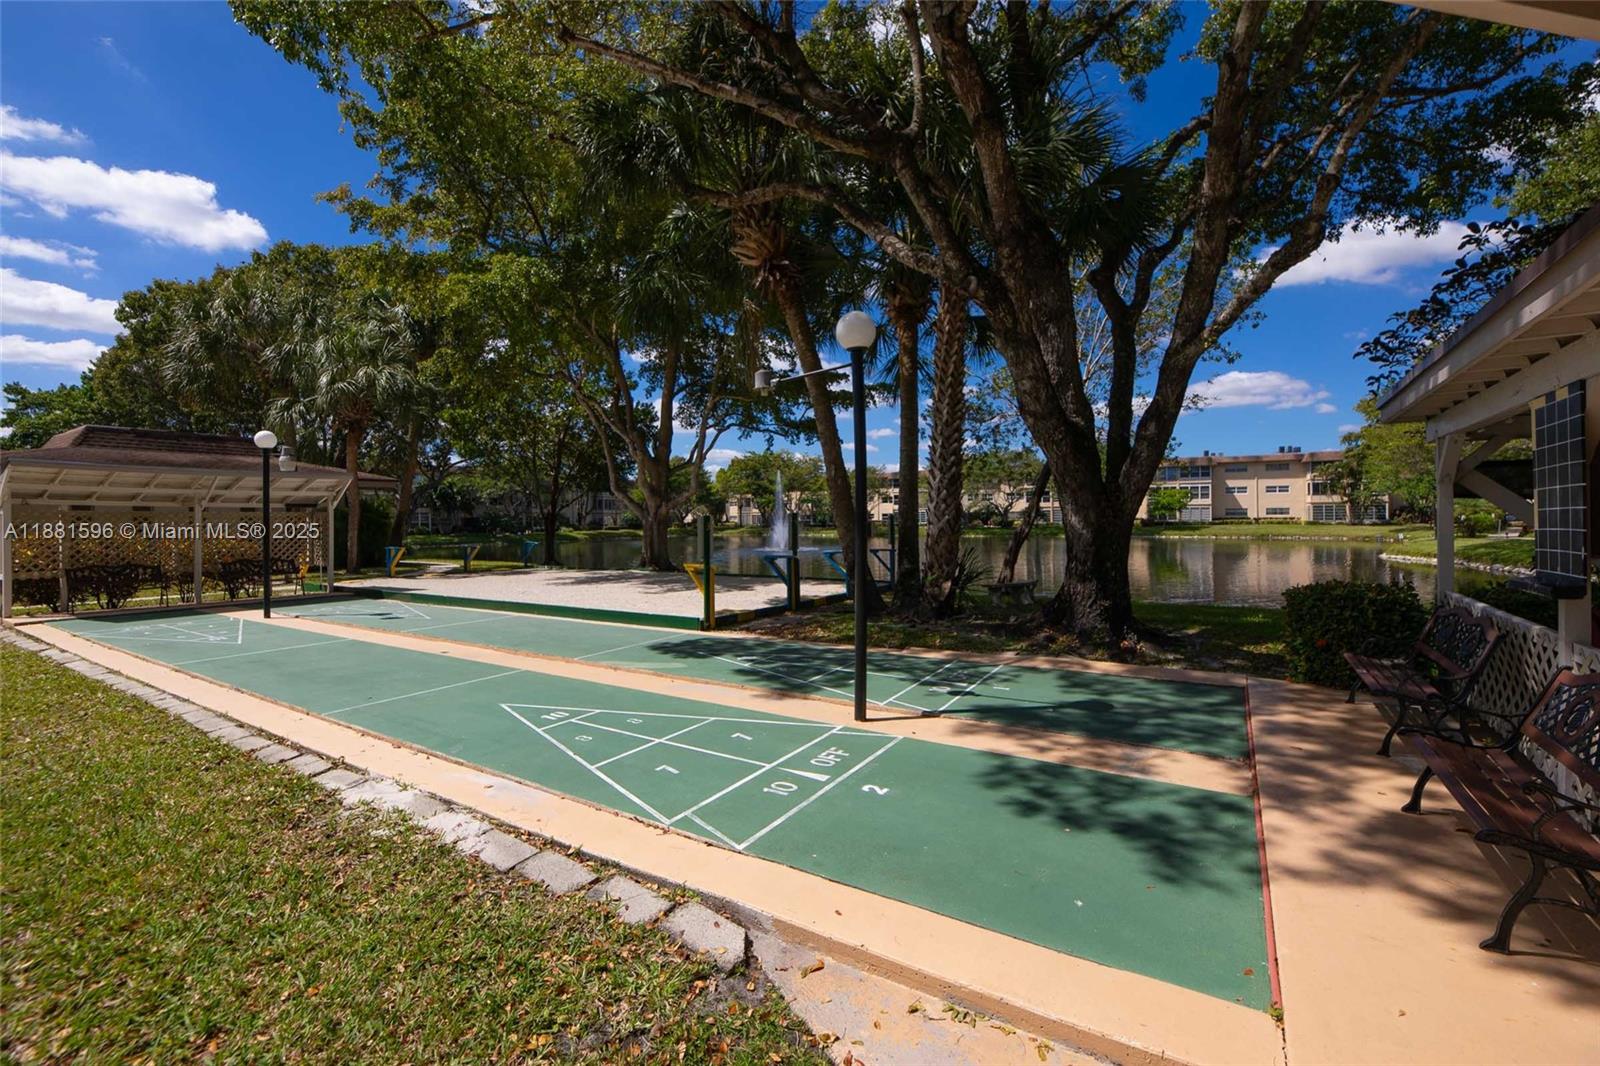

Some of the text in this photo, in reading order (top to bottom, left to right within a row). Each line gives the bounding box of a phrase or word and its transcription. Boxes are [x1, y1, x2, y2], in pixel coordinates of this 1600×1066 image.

[541, 711, 570, 720] 10
[730, 732, 752, 740] 7
[654, 764, 680, 774] 7
[762, 746, 850, 796] 10 OFF
[861, 784, 890, 796] 2
